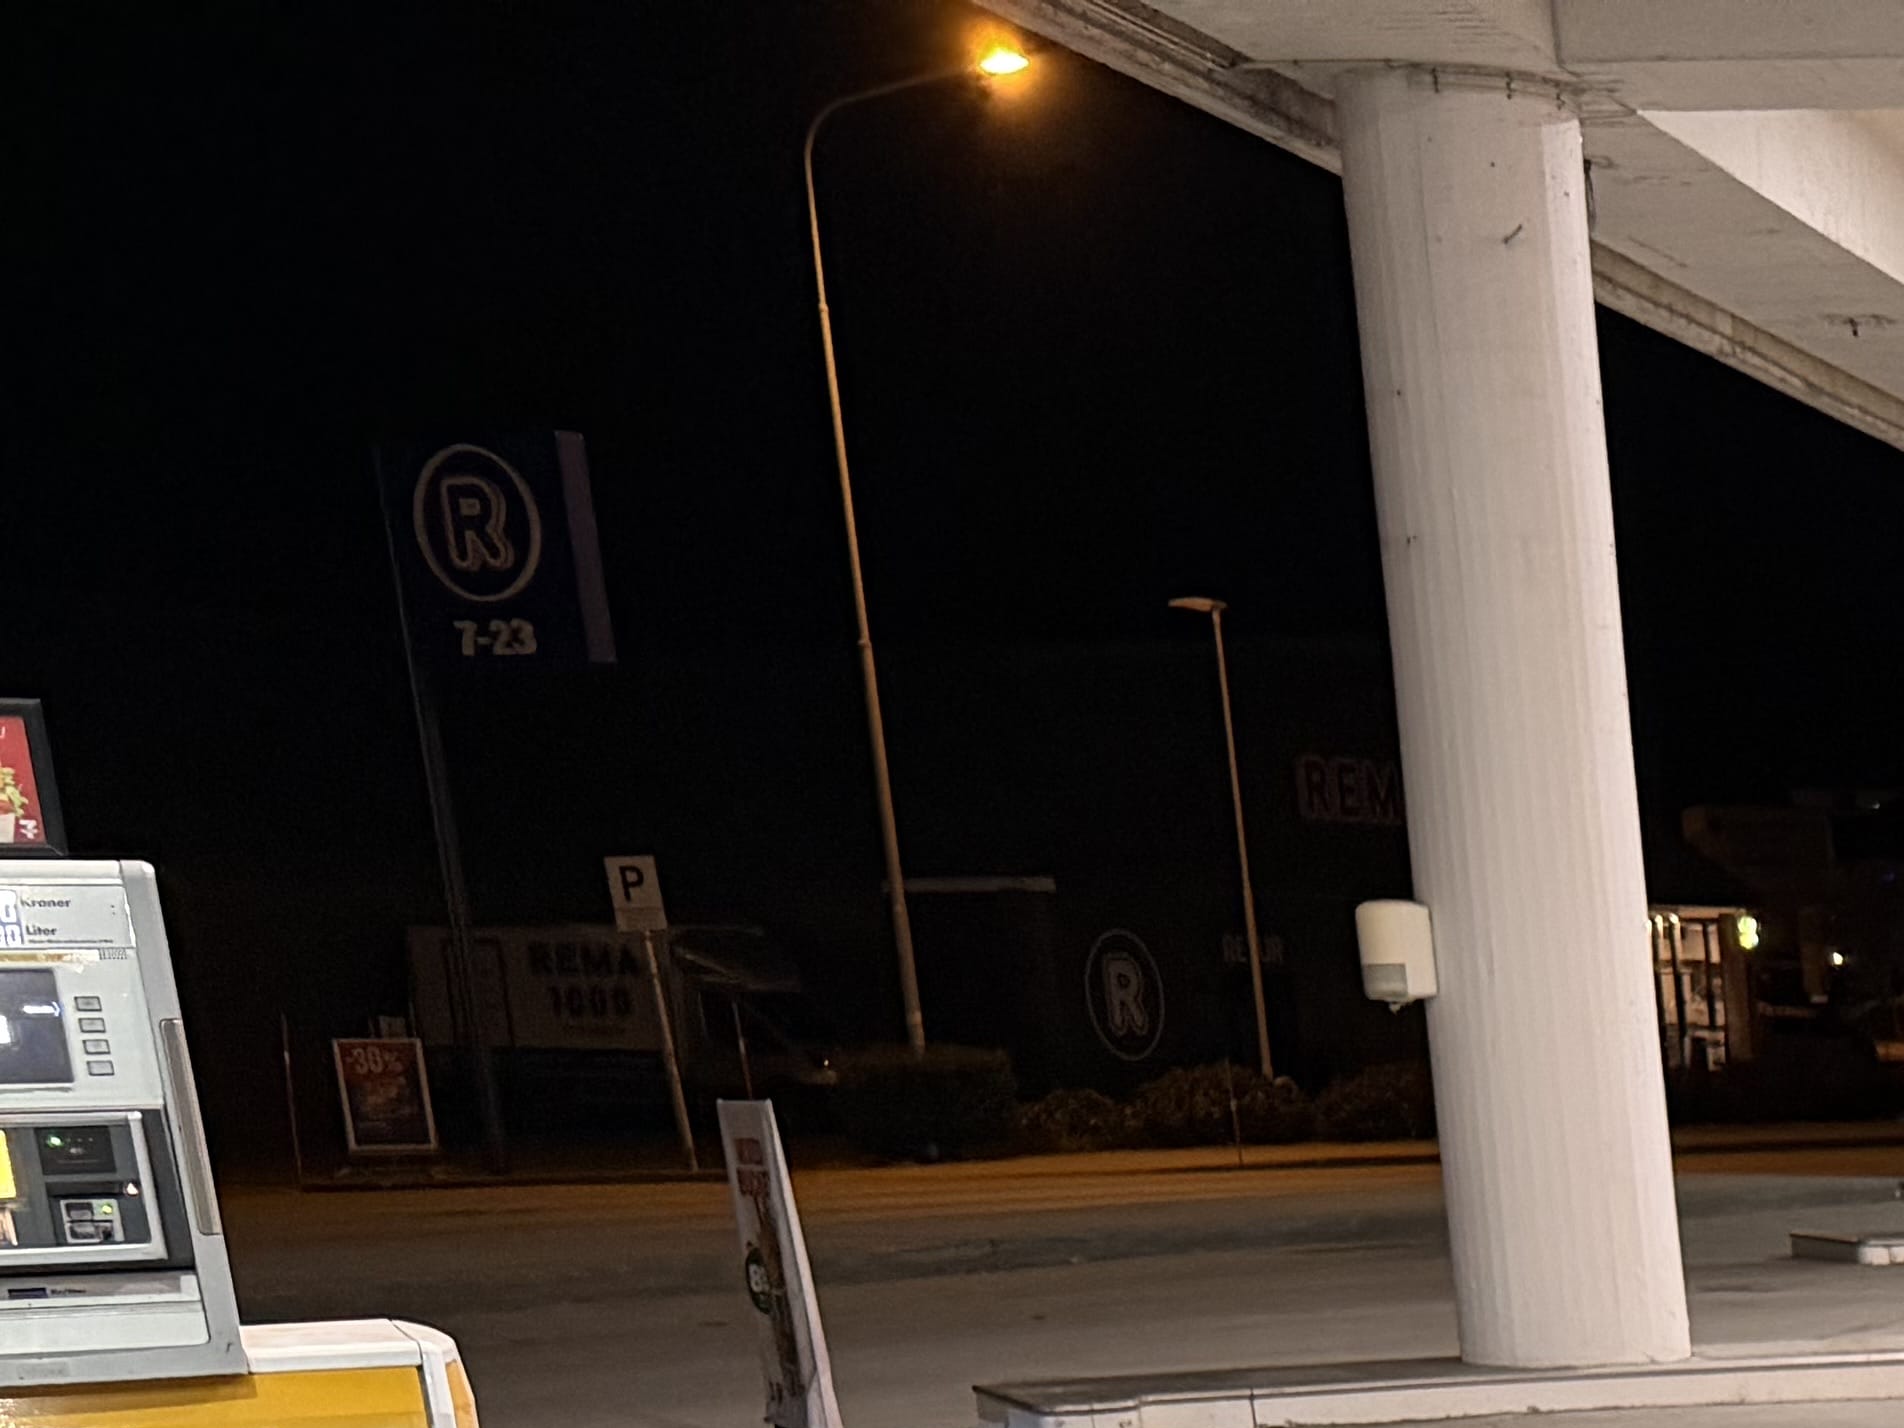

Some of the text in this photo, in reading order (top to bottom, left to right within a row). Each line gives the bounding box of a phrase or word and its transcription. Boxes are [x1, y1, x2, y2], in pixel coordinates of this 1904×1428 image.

[452, 618, 537, 657] 7-23
[618, 865, 645, 903] P
[20, 897, 72, 908] Kroner
[26, 925, 58, 936] Liter
[528, 938, 641, 977] REMA
[1223, 936, 1284, 963] REUR
